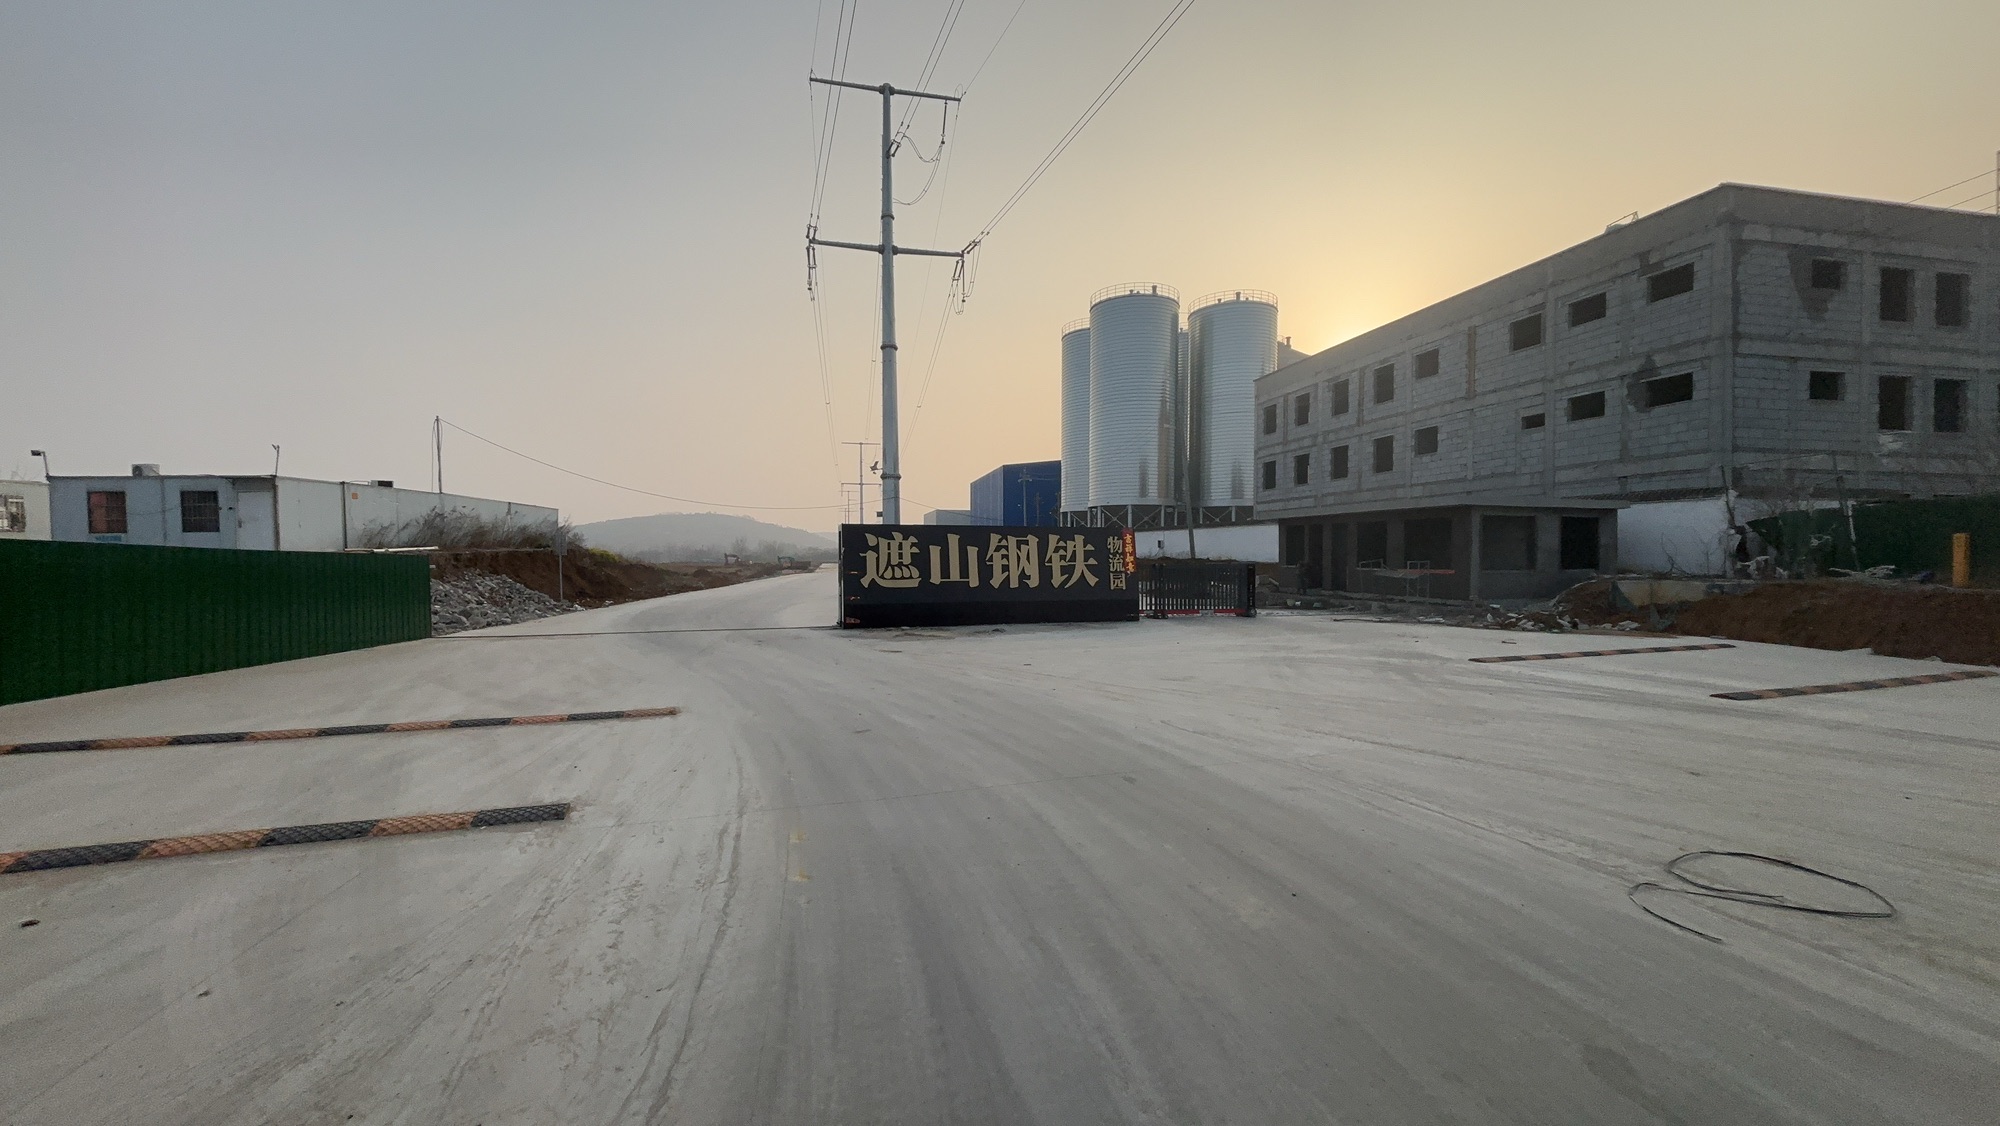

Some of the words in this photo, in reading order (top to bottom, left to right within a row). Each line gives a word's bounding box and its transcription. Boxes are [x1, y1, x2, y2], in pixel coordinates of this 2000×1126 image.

[860, 531, 1099, 589] 遮山钢铁
[1107, 536, 1126, 590] 物流园
